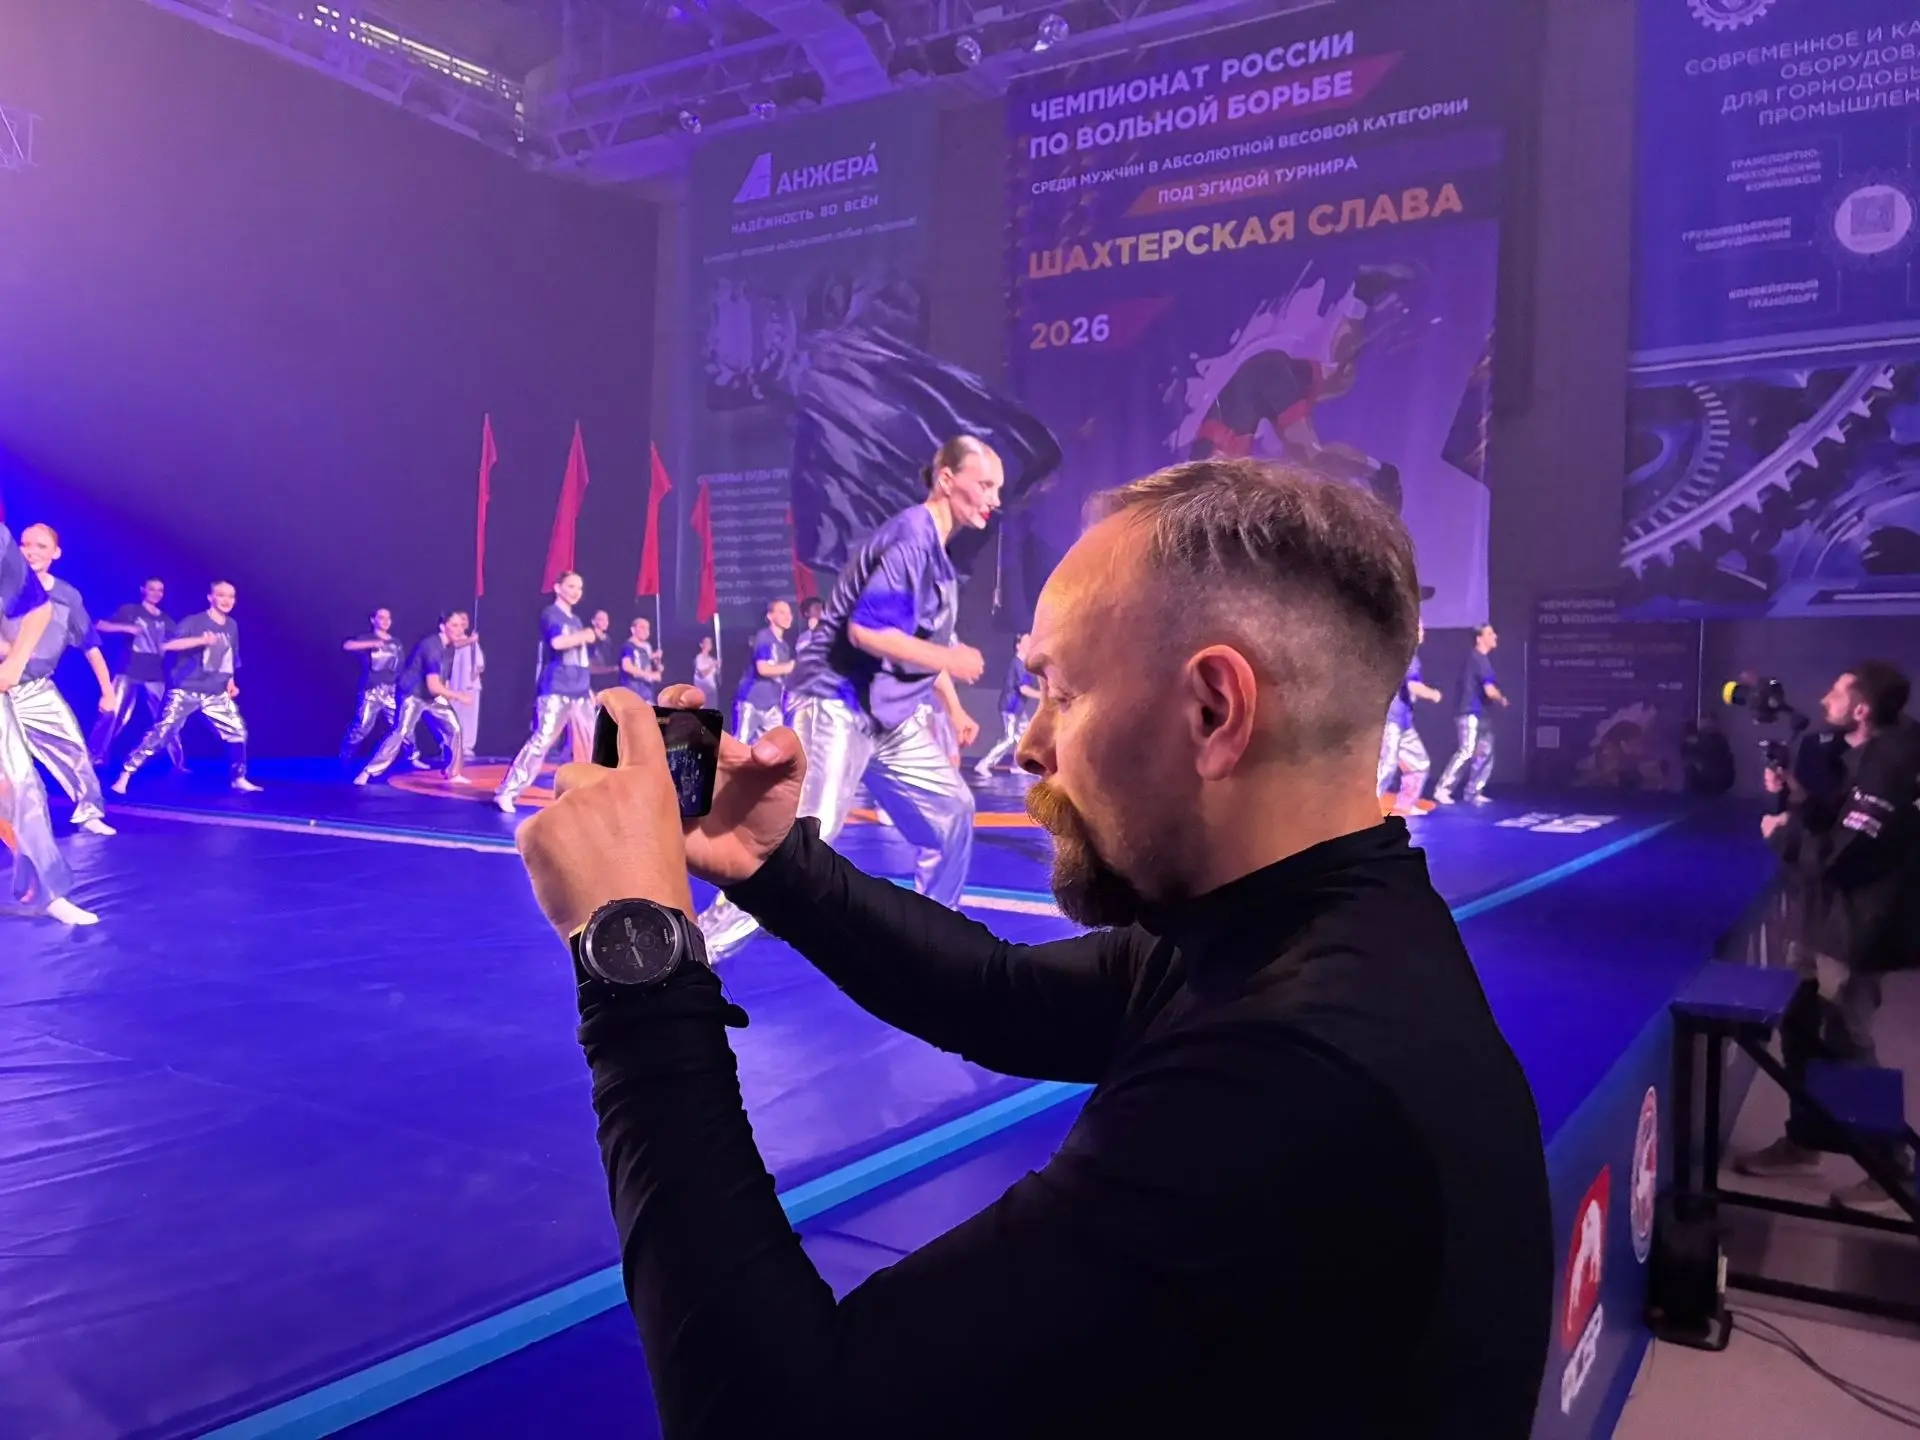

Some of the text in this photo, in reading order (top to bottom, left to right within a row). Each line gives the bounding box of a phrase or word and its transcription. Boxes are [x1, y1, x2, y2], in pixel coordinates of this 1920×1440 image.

[1684, 30, 1860, 75] СОВРЕМЕННОЕ
[1866, 26, 1882, 43] И
[1780, 43, 1920, 79] ОБОРУДОВ
[1031, 30, 1355, 122] ЧЕМПИОНАТ РОССИИ
[1030, 70, 1353, 159] ПО ВОЛЬНОЙ БОРЬБЕ
[1720, 89, 1768, 115] ДЛЯ
[1031, 97, 1469, 195] СРЕДИ МУЖЧИН В АБСОЛЮТНОЙ ВЕСОВОЙ КАТЕГОРИИ
[1158, 156, 1358, 204] ПОД ЭГИДОЙ ТУРНИРА
[820, 203, 838, 218] ВО
[1028, 183, 1463, 279] ШАХТЕРСКАЯ СЛАВА
[1029, 314, 1110, 350] 2026
